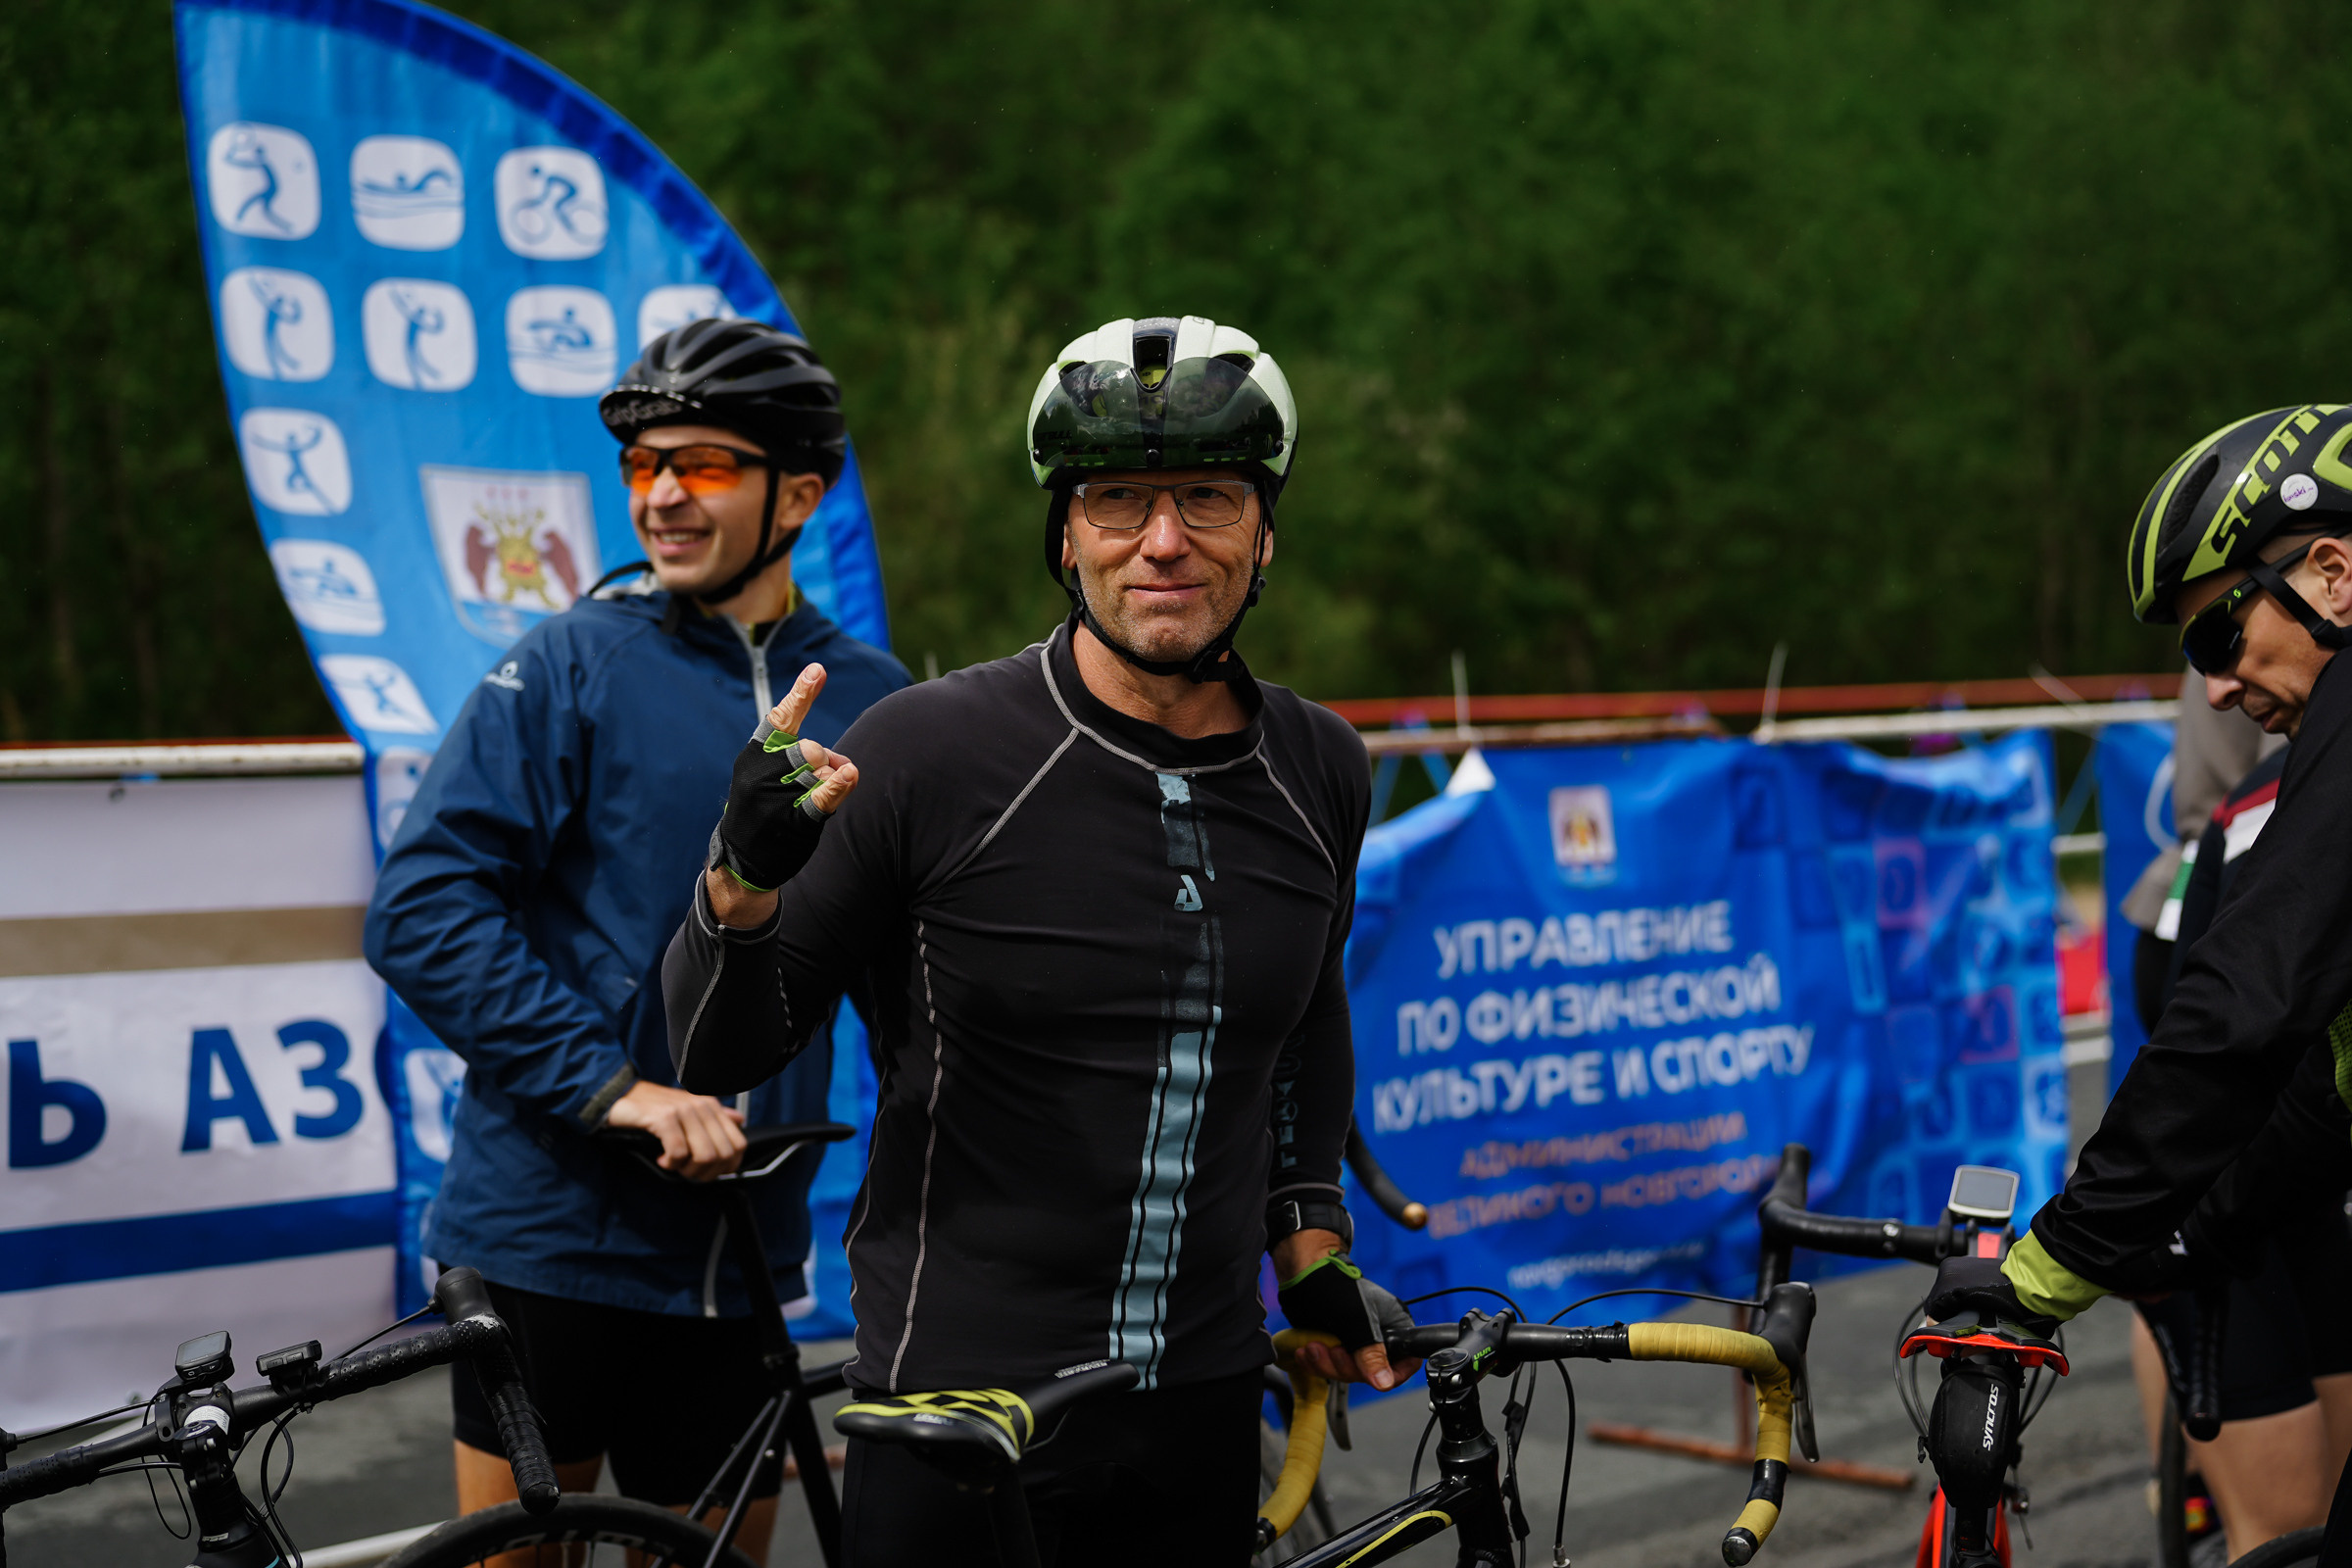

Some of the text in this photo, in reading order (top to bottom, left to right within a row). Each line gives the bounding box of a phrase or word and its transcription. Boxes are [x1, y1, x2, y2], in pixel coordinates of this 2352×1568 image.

[1434, 901, 1734, 979] УПРАВЛЕНИЕ
[1397, 953, 1782, 1055] ПО ФИЗИЧЕСКОЙ
[1372, 1050, 1605, 1134] КУЛЬТУРЕ
[1612, 1047, 1647, 1100] И
[1650, 1023, 1815, 1093] СПОРТУ
[1427, 1182, 1595, 1240] ВЕЛИКОГО
